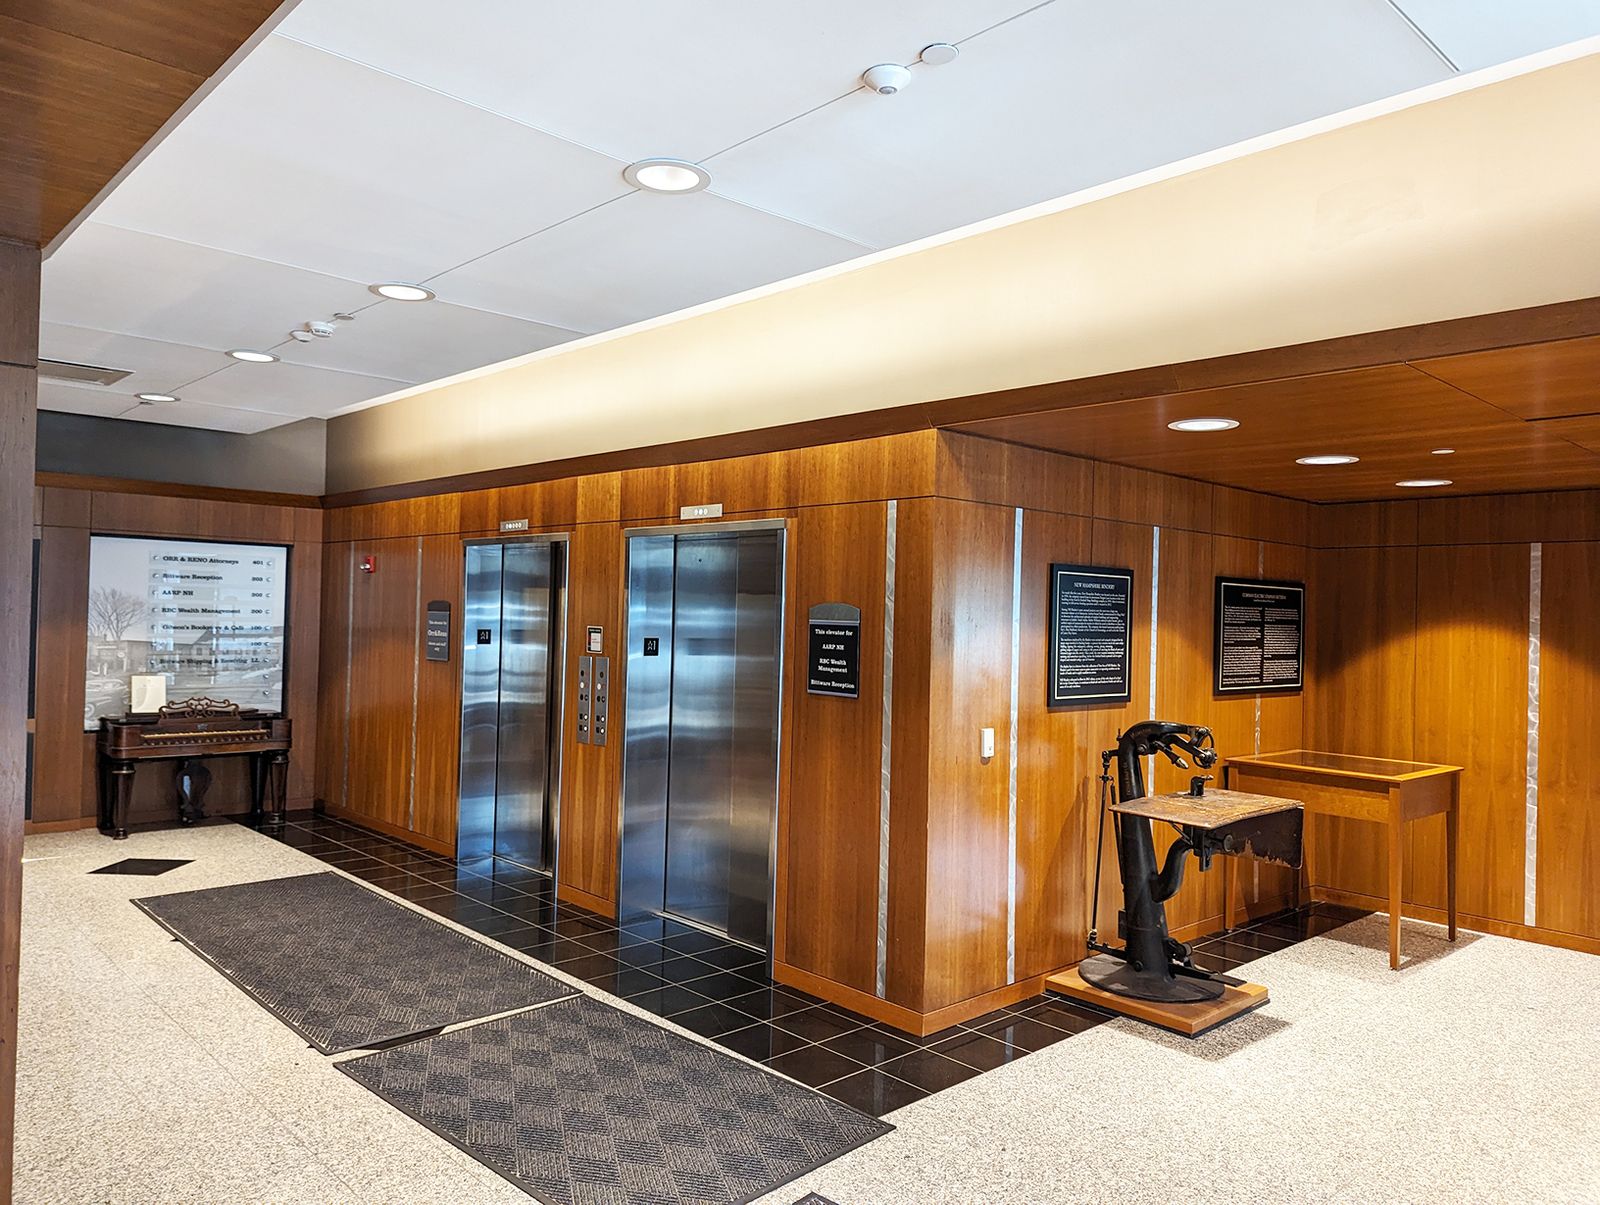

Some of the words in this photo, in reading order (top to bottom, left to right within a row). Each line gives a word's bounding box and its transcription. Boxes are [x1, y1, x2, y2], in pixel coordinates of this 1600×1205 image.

[187, 556, 208, 564] RENO
[818, 665, 848, 674] Management
[811, 679, 831, 687] Bittware
[831, 680, 855, 689] Reception
